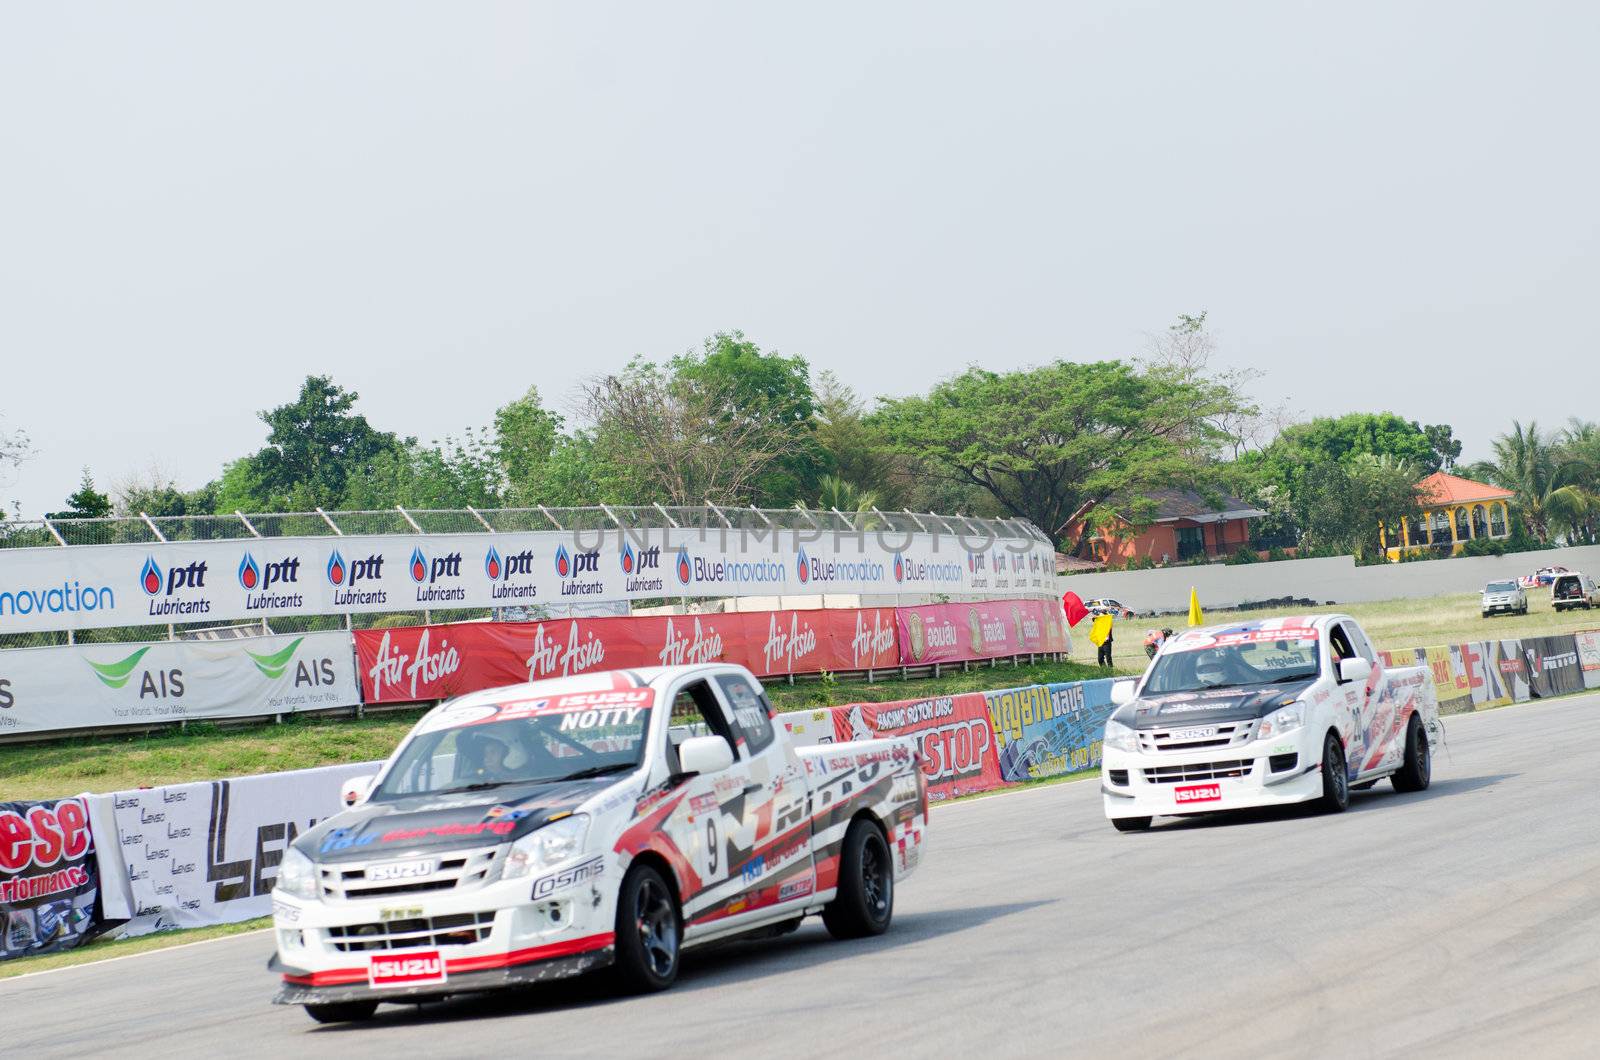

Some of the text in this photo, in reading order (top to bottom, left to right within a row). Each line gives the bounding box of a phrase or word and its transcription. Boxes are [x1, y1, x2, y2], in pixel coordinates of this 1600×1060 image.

[430, 551, 462, 583] ptt
[504, 550, 533, 581] ptt
[572, 549, 600, 578] ptt
[637, 545, 660, 569] ptt
[167, 560, 208, 595] ptt
[263, 556, 300, 590] ptt
[349, 553, 384, 586] ptt
[416, 586, 465, 601] Lubricants
[492, 583, 536, 599] Lubricants
[561, 581, 603, 596] Lubricants
[626, 578, 663, 592] Lubricants
[149, 598, 210, 616] Lubricants
[247, 593, 303, 610] Lubricants
[334, 589, 387, 606] Lubricants
[295, 657, 336, 688] AIS
[140, 669, 185, 699] AIS
[559, 692, 648, 706] ISUZU
[935, 698, 954, 717] DISC
[560, 707, 642, 731] NOTTY
[1172, 729, 1213, 740] ISUZU
[1176, 788, 1221, 801] ISUZU
[706, 818, 718, 876] 9
[371, 861, 432, 880] ISUZU
[373, 955, 442, 977] ISUZU
